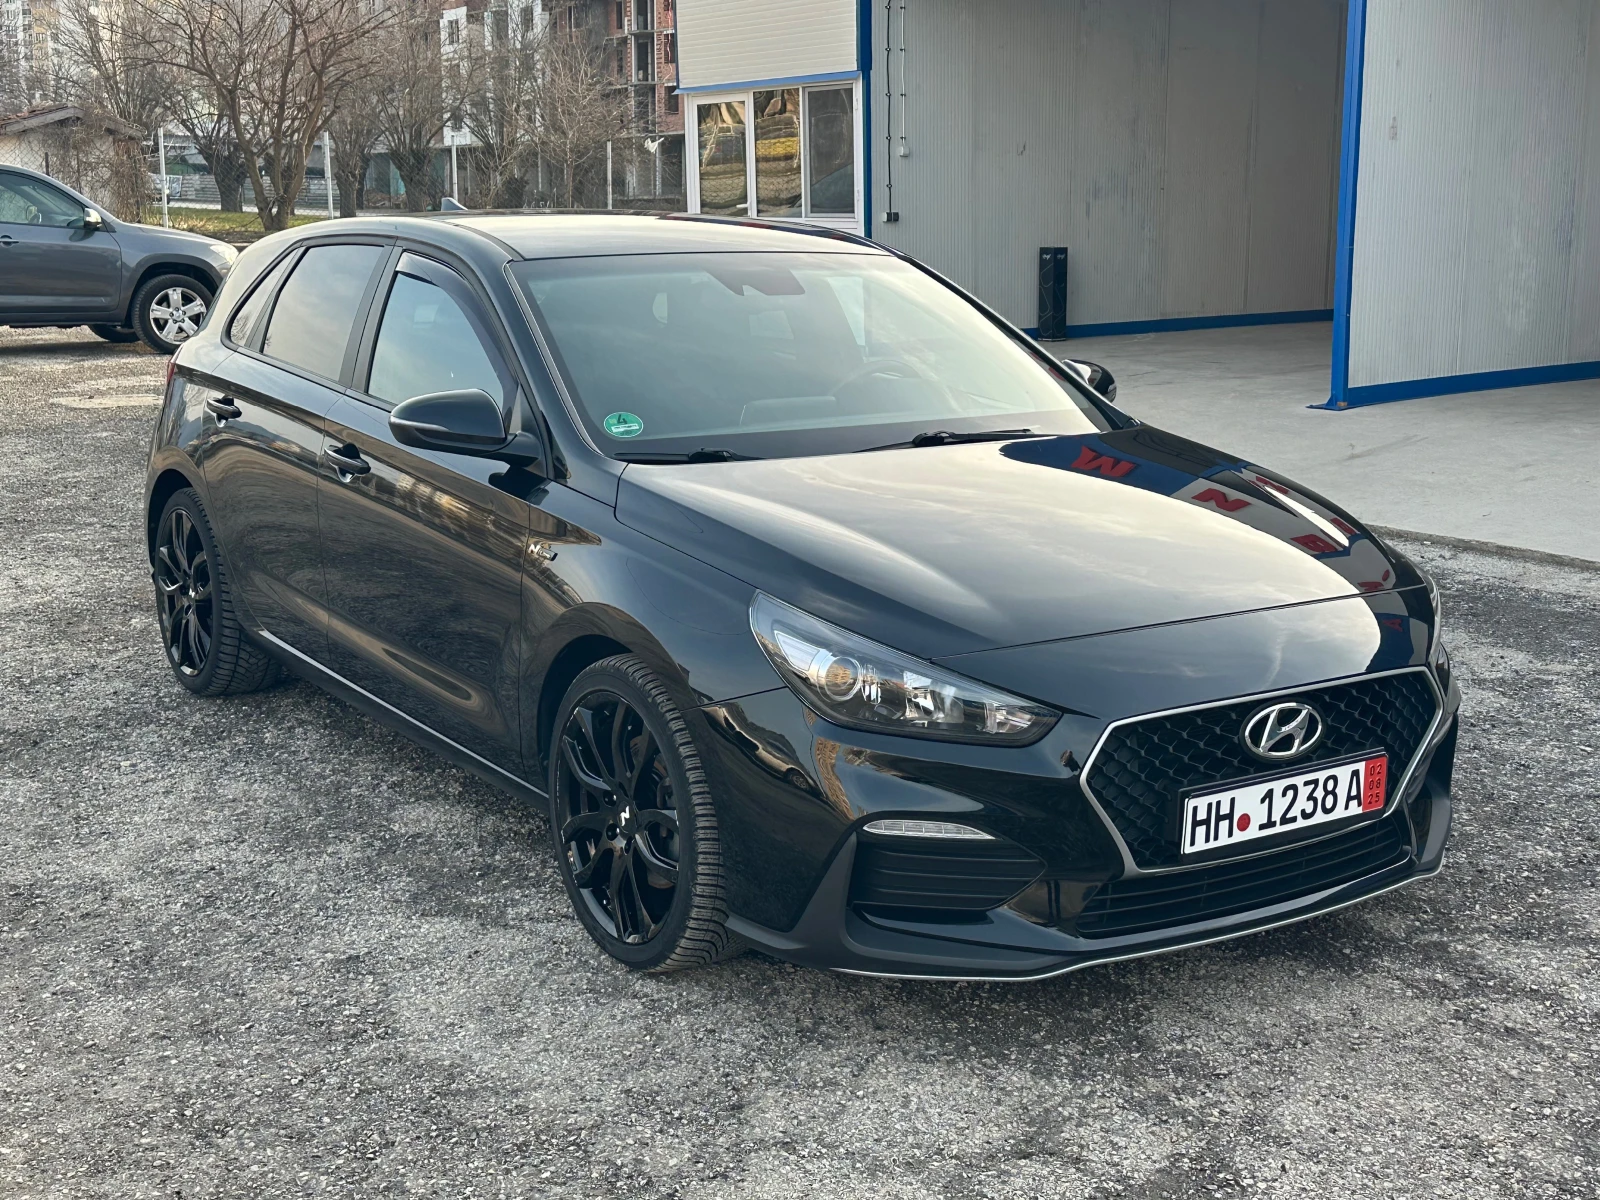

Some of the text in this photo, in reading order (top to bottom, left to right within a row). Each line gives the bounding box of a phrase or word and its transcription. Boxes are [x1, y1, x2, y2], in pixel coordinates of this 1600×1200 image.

[1370, 762, 1382, 776] 02
[1369, 777, 1381, 791] 08
[1367, 790, 1380, 805] 25
[1189, 796, 1236, 848] HH
